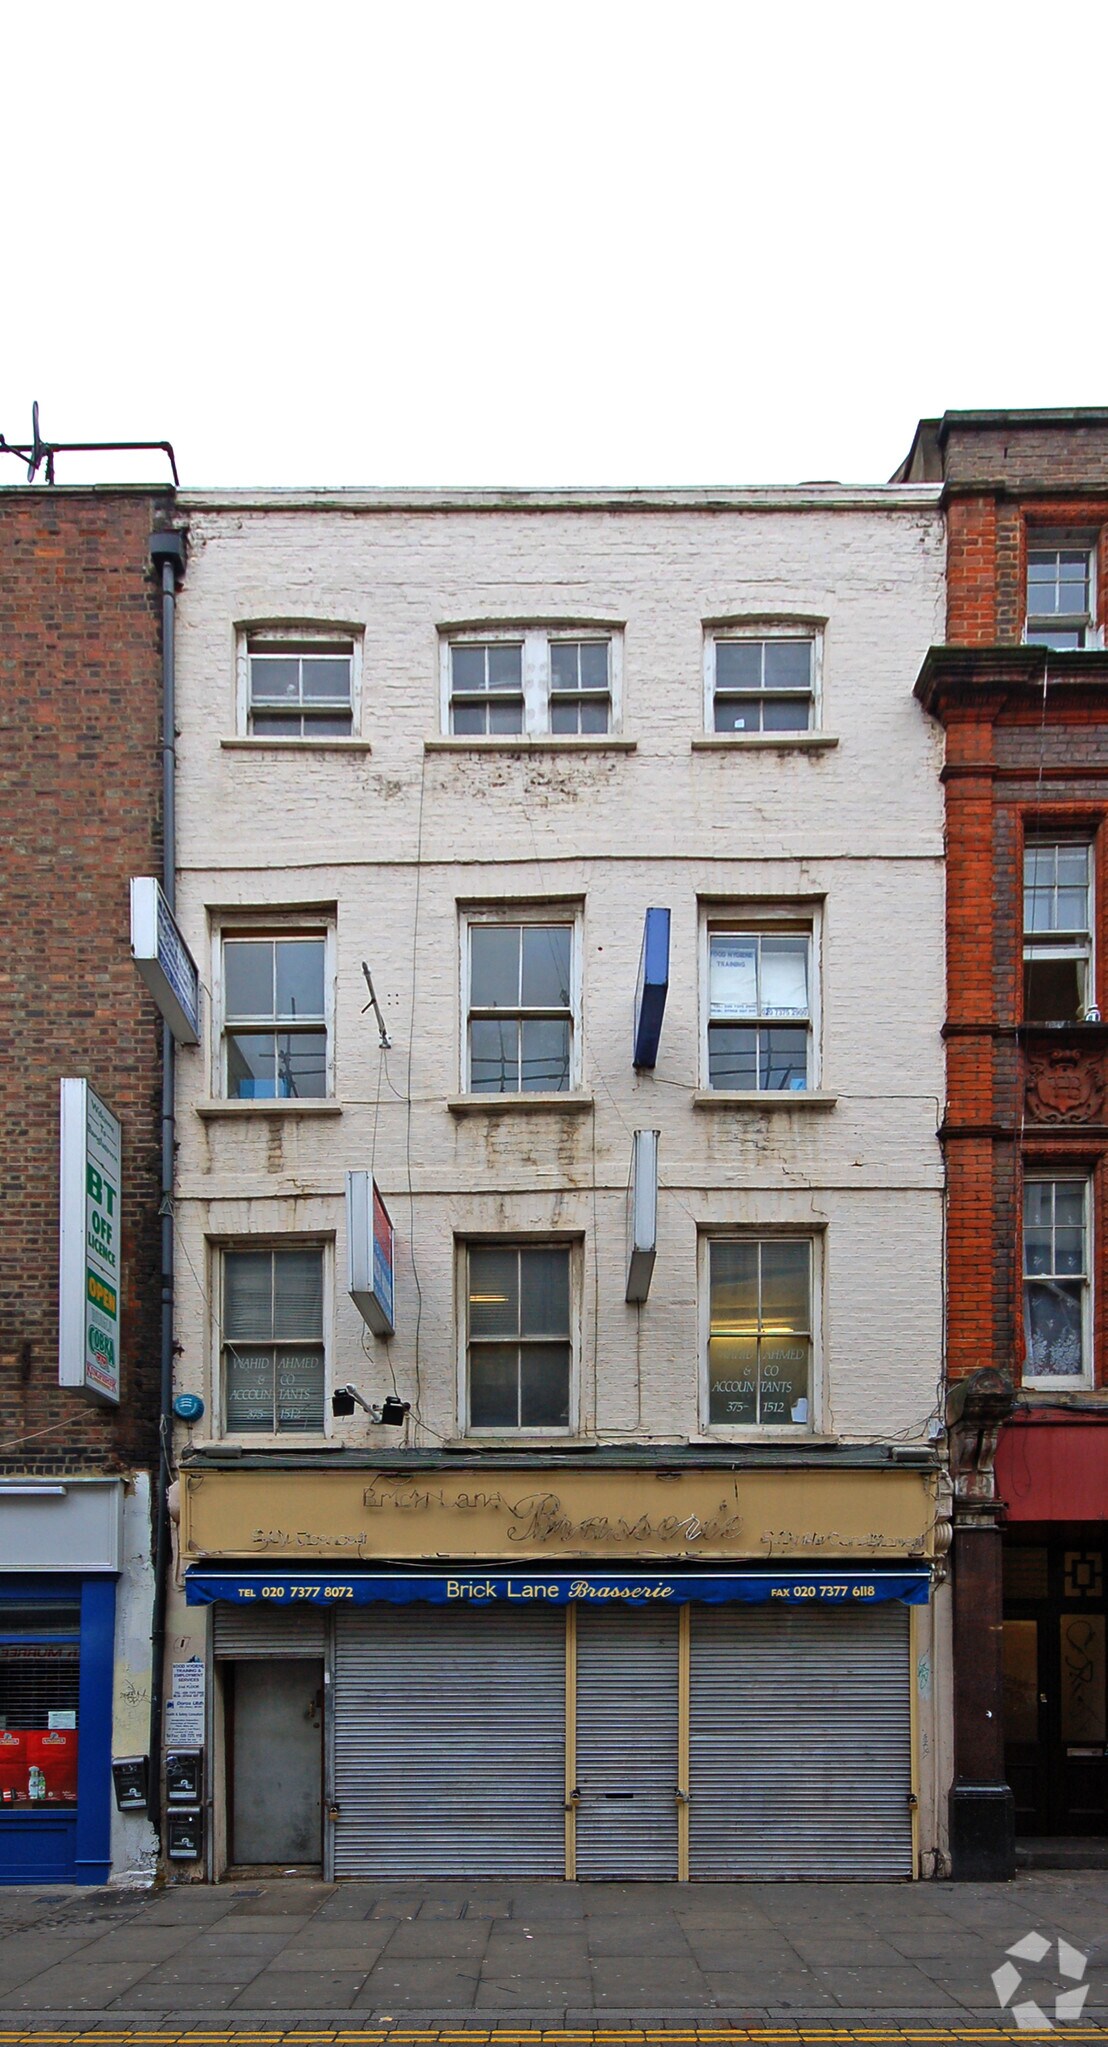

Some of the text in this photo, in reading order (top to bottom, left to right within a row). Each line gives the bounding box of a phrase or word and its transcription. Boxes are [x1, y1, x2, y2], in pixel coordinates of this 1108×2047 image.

[87, 1162, 117, 1218] BT
[92, 1210, 112, 1245] OFF
[88, 1231, 116, 1268] LICENCE
[89, 1276, 116, 1313] OPEN
[88, 1323, 116, 1368] COBRA
[763, 1348, 805, 1360] AHMED
[233, 1358, 319, 1369] WAHID AHMED
[743, 1365, 779, 1377] & CO
[280, 1373, 296, 1386] CO
[506, 1491, 745, 1542] Brasserie
[238, 1586, 354, 1598] TEL 020 7377 8072
[446, 1580, 675, 1598] Brick Lane Brasserie
[771, 1585, 875, 1597] FAX 020 7377 6118
